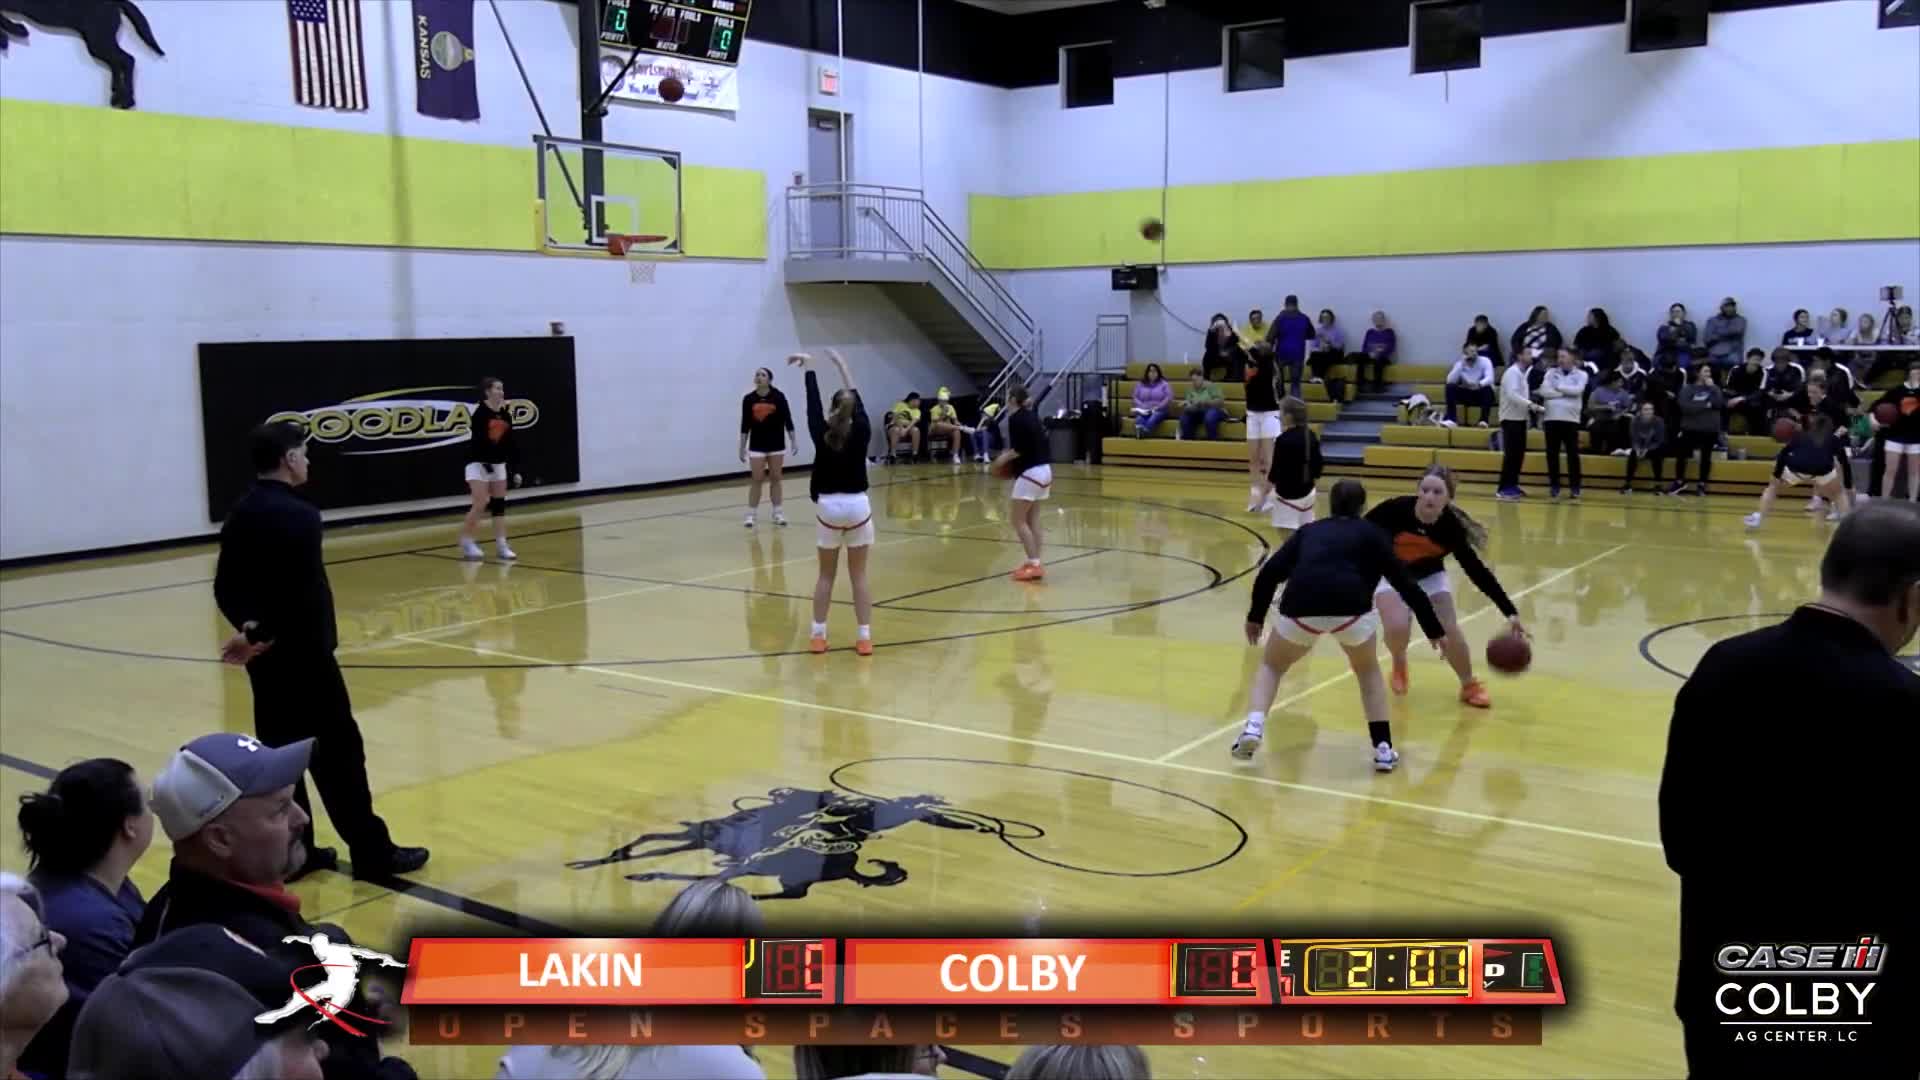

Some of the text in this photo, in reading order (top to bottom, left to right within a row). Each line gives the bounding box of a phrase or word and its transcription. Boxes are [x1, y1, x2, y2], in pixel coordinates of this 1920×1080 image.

[615, 9, 627, 31] 0
[418, 15, 431, 79] KANSAS
[720, 30, 732, 50] 0
[265, 398, 539, 446] OODLAD
